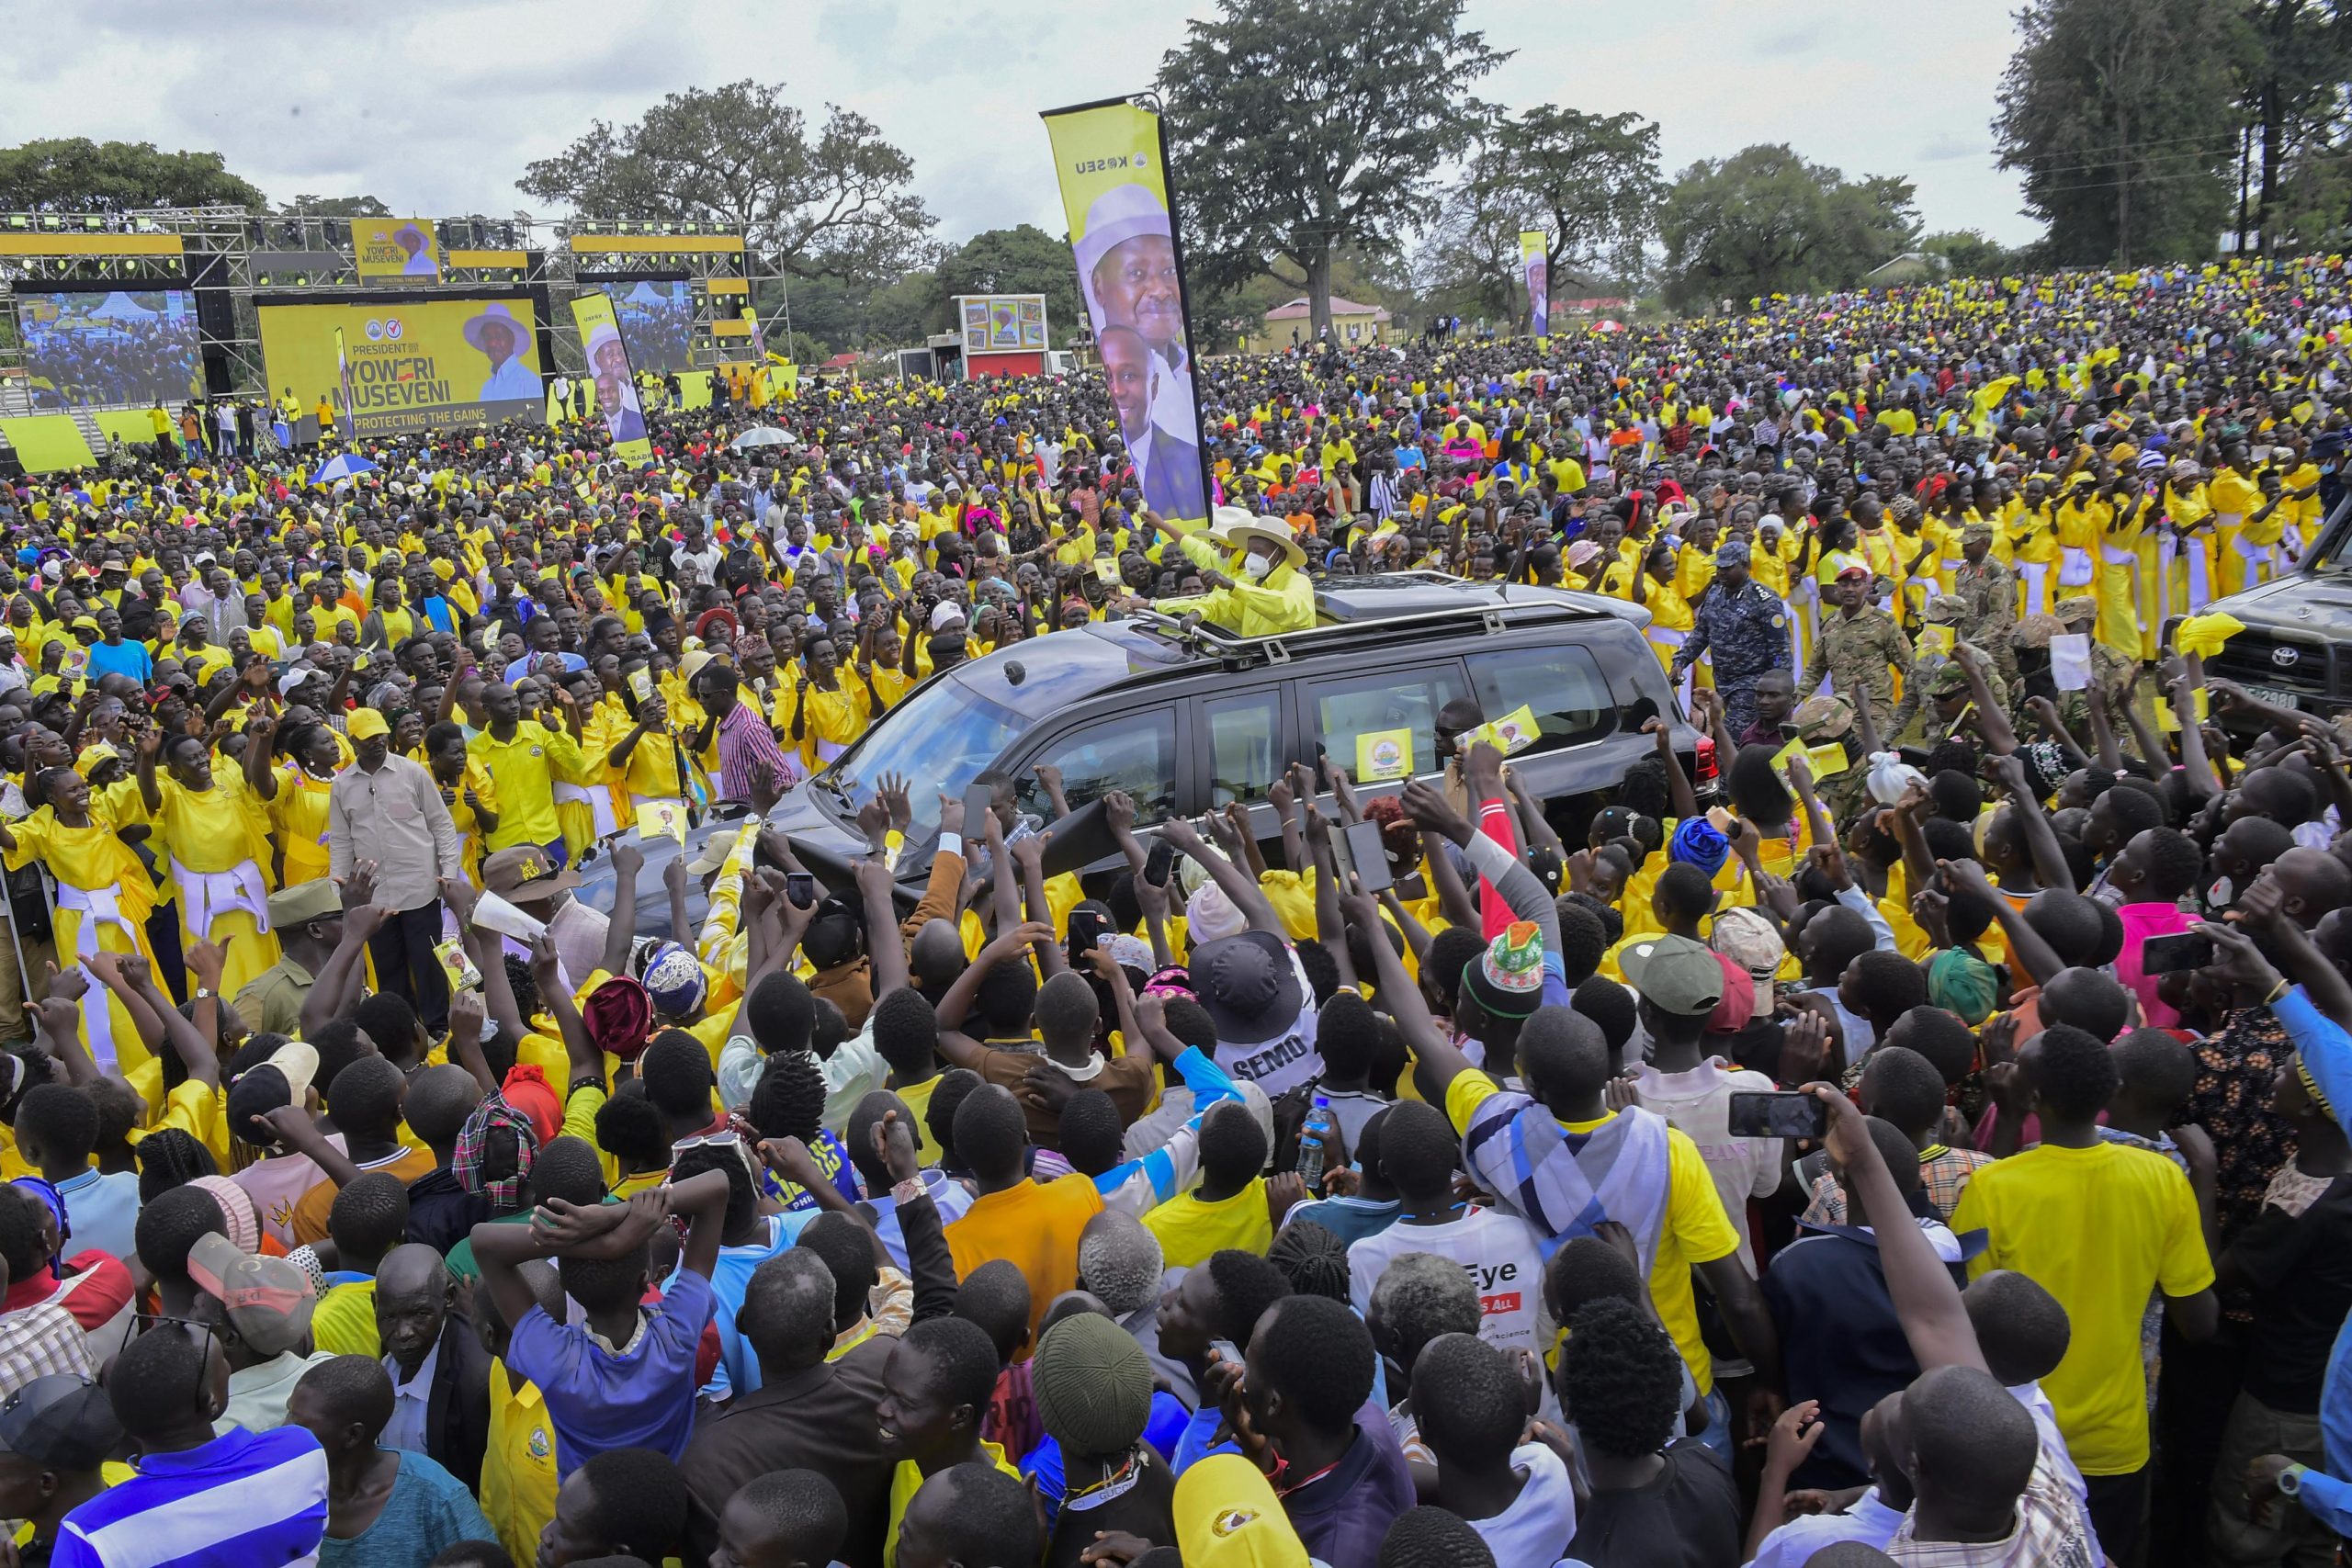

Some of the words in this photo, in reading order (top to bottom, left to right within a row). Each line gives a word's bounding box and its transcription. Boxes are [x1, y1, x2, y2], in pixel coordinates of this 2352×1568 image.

[362, 254, 404, 264] MUSEVENI
[353, 344, 407, 355] PRESIDENT
[345, 356, 435, 385] YOWERI
[332, 379, 451, 411] MUSEVENI
[354, 412, 426, 431] PROTECTING
[428, 410, 452, 423] THE
[453, 408, 487, 422] GAINS
[522, 866, 540, 881] PLU
[1232, 1034, 1307, 1081] SEMO
[1463, 1262, 1518, 1292] Eye
[1099, 1483, 1133, 1500] GUCCI
